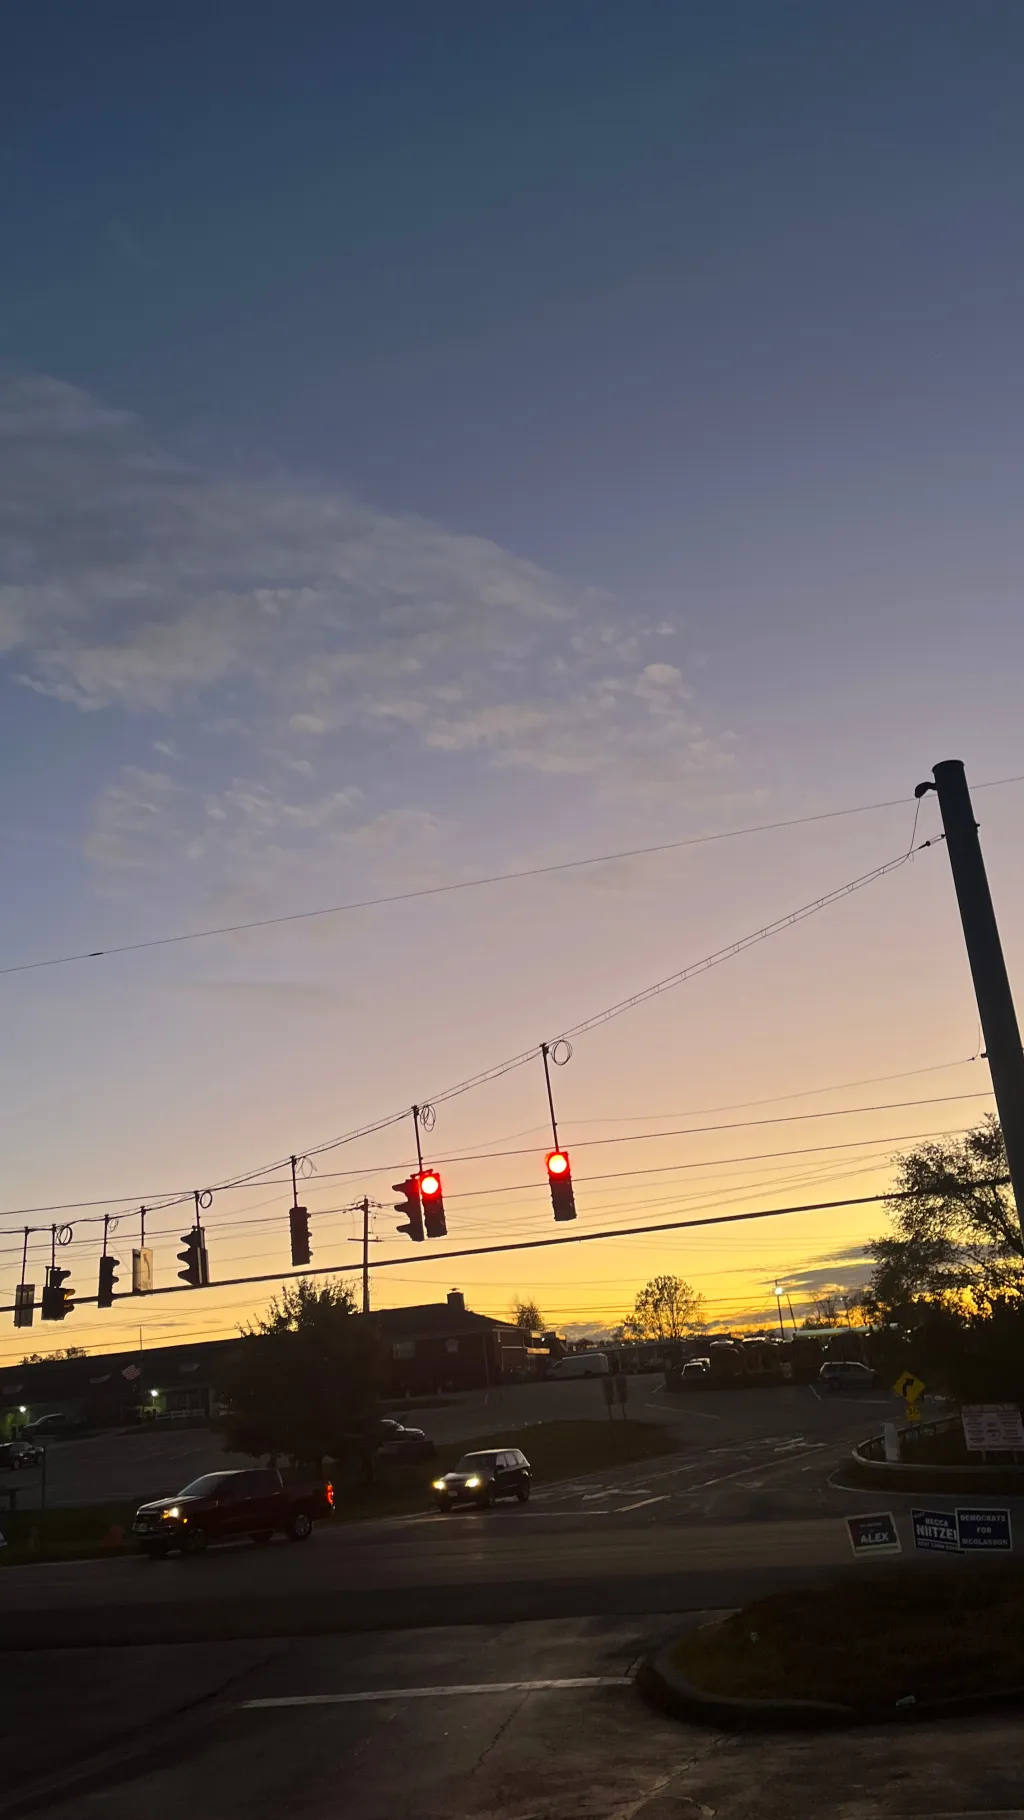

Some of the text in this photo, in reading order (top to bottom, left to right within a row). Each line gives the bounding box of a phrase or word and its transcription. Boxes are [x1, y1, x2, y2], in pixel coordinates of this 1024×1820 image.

[925, 1517, 949, 1527] BECCA
[960, 1514, 1006, 1522] DEMOCRATS
[861, 1532, 889, 1544] ALEX
